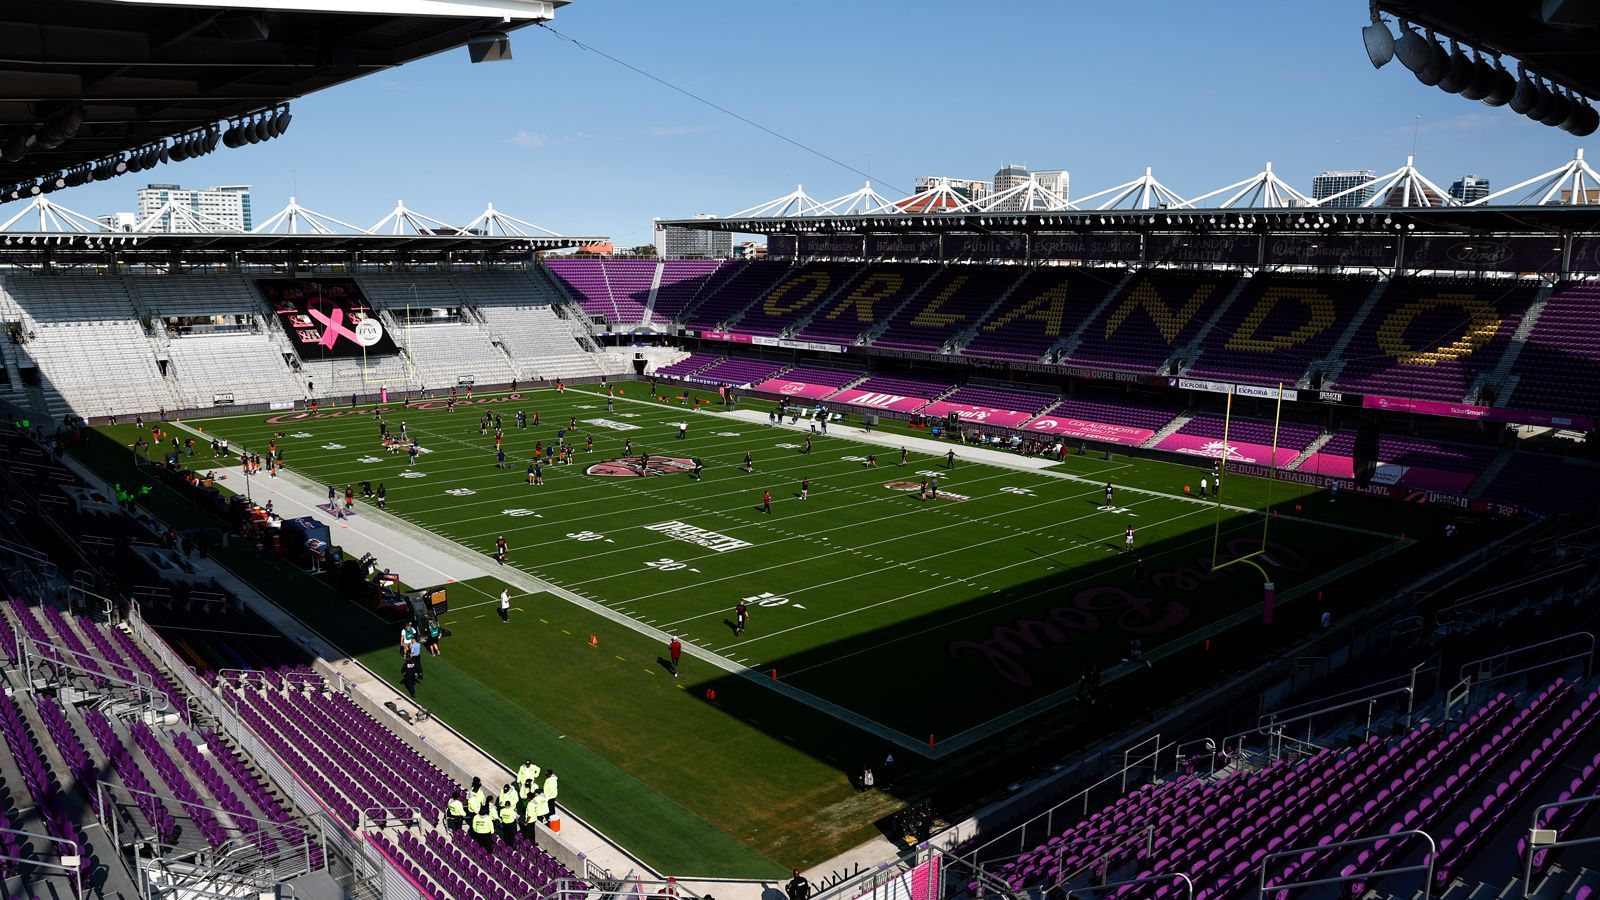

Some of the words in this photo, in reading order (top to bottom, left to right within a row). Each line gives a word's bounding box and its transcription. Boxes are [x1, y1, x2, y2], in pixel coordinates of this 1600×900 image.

[963, 240, 1001, 253] Publix
[763, 270, 1502, 366] ORLANDO
[930, 353, 948, 363] CURE
[1028, 363, 1056, 375] DULUTH
[1057, 365, 1091, 379] TRADING
[1092, 368, 1114, 381] CURE
[1115, 371, 1139, 383] BOWL
[1180, 380, 1208, 390] EXPLORIA
[1238, 387, 1268, 398] EXPLORIA
[1450, 406, 1490, 417] TicketSmarter
[1090, 421, 1141, 437] AUTOMOTIVE
[1063, 429, 1085, 439] FLEET
[1085, 431, 1120, 444] SERVICES
[1278, 470, 1323, 487] TRADING
[566, 530, 605, 542] 30
[643, 520, 755, 553] DULUTH
[644, 557, 688, 571] 20
[742, 591, 790, 608] 10
